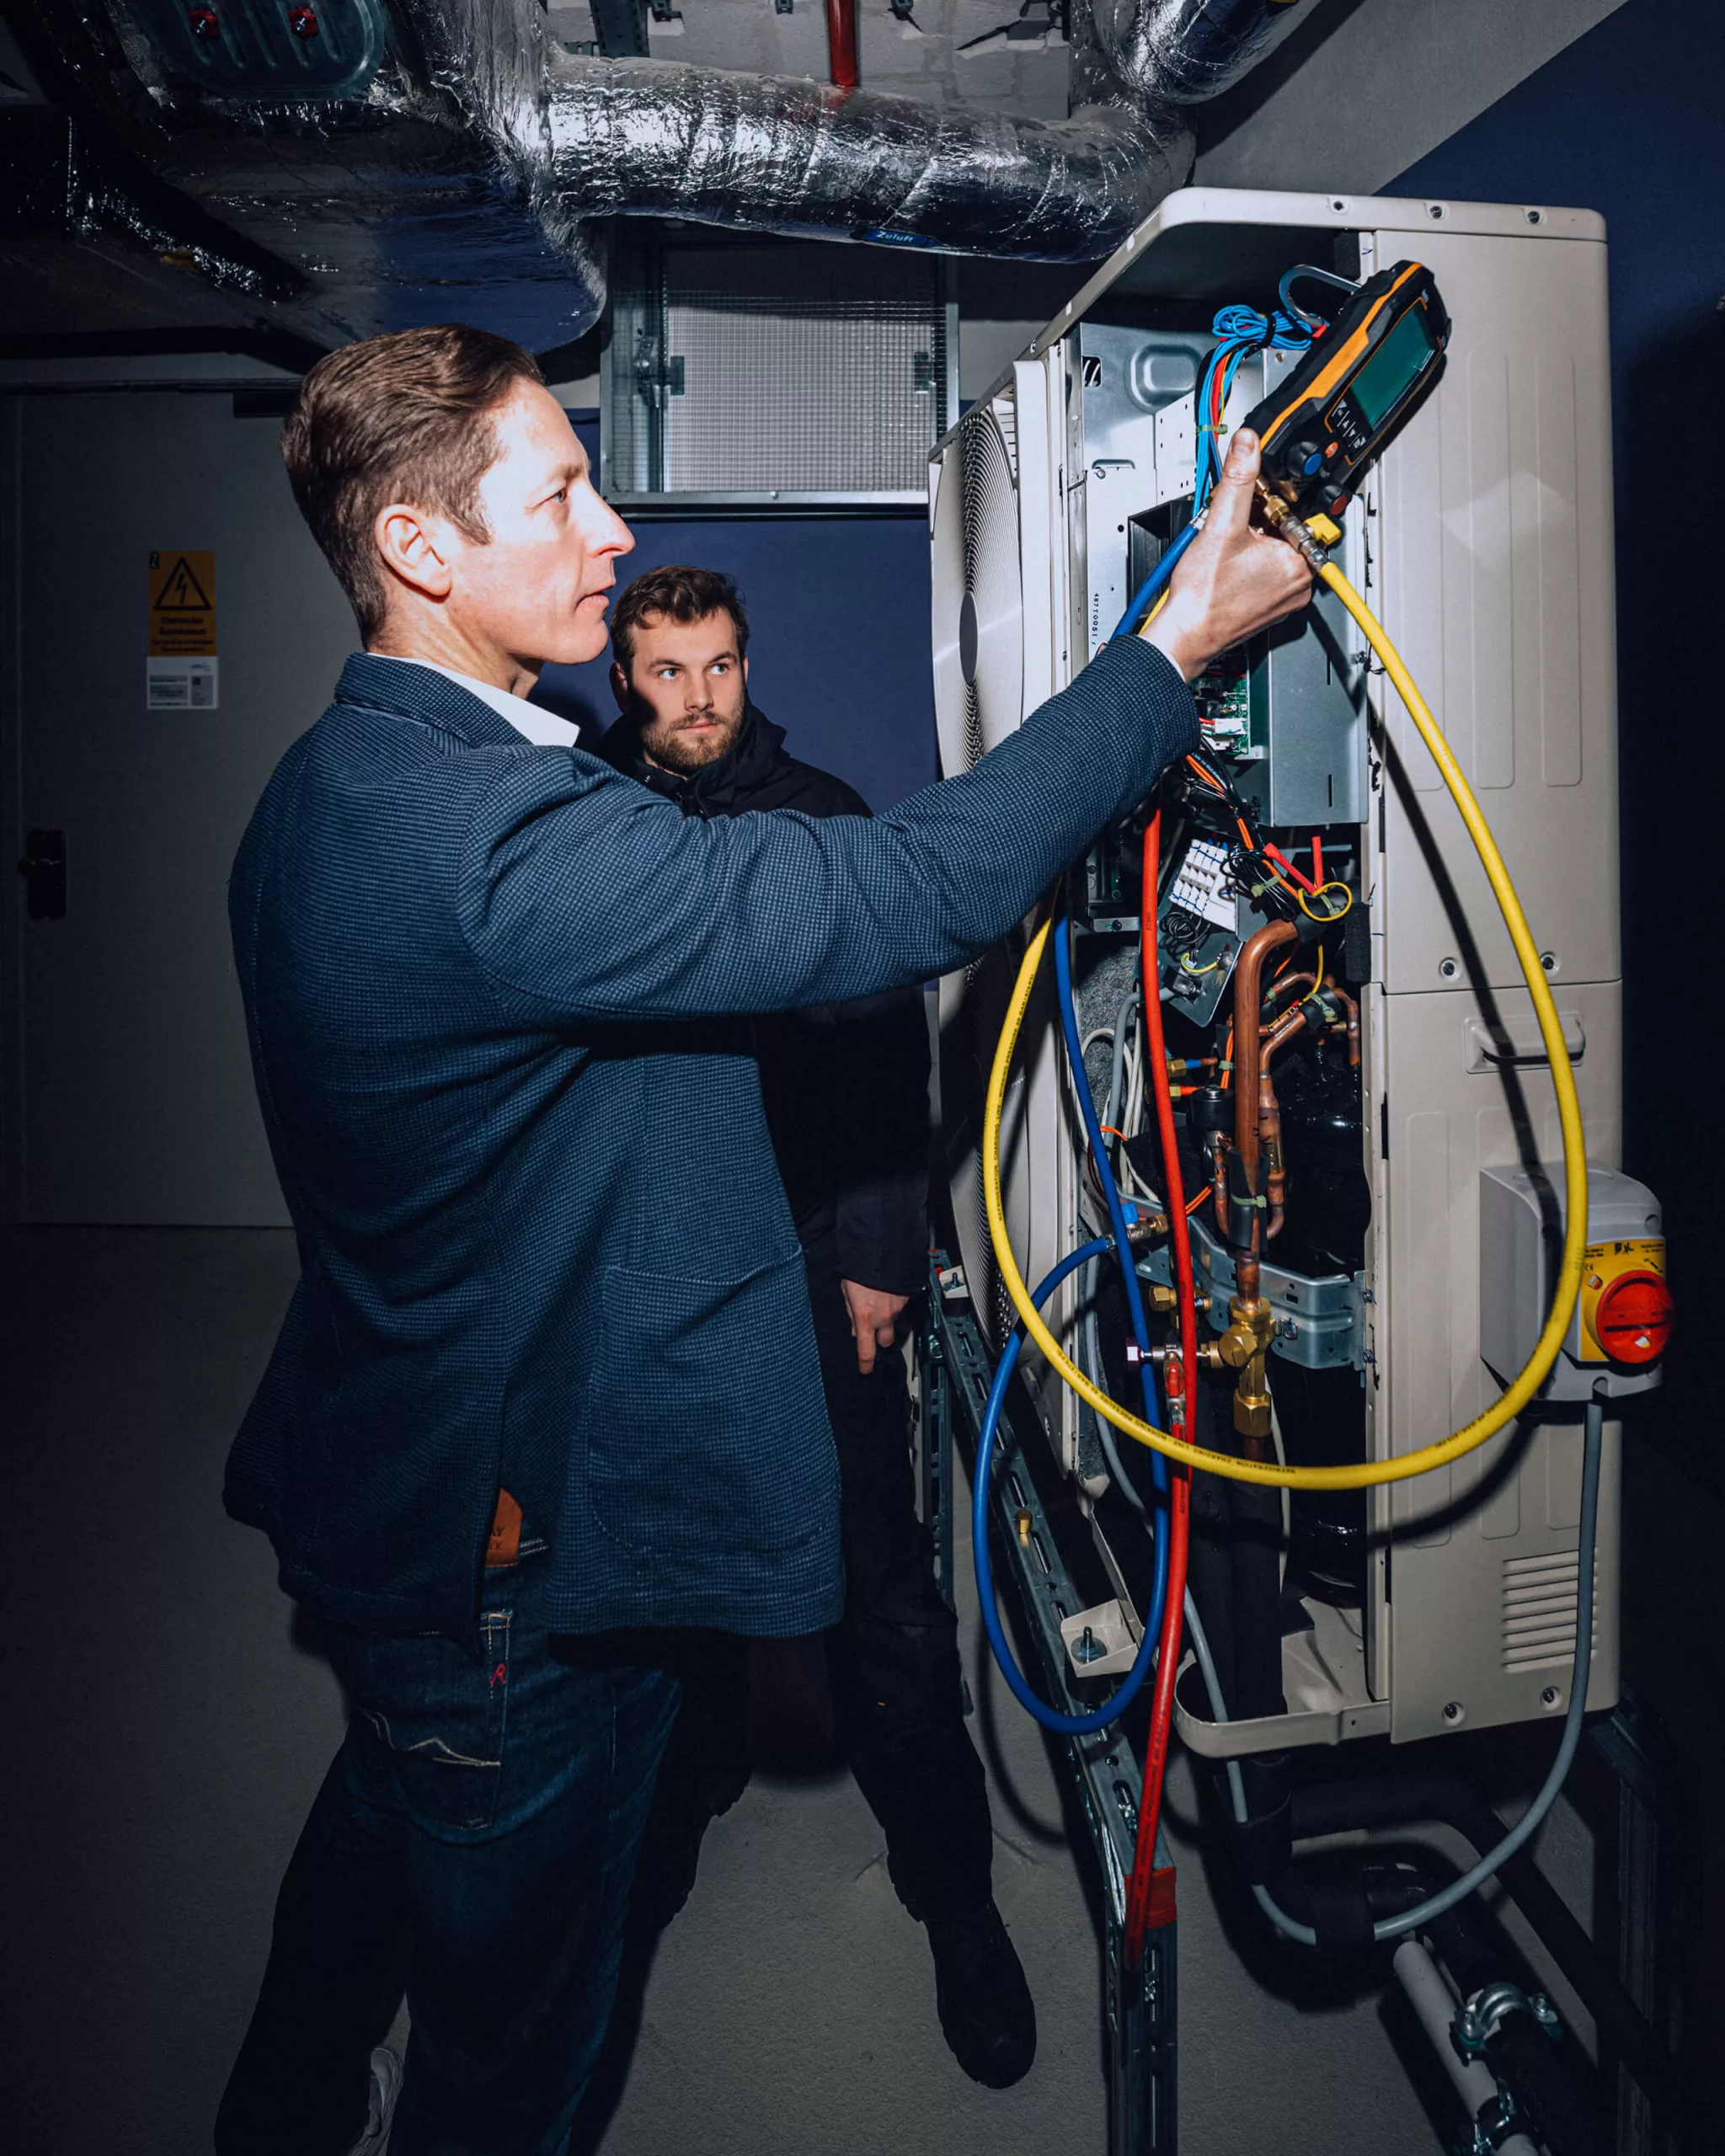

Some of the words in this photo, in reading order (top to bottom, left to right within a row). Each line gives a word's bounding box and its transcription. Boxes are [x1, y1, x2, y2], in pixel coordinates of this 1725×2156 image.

[876, 231, 914, 243] Zuluft
[999, 1065, 1008, 1097] WORKING
[1006, 1027, 1018, 1063] PRESSURE
[489, 1663, 506, 1685] R
